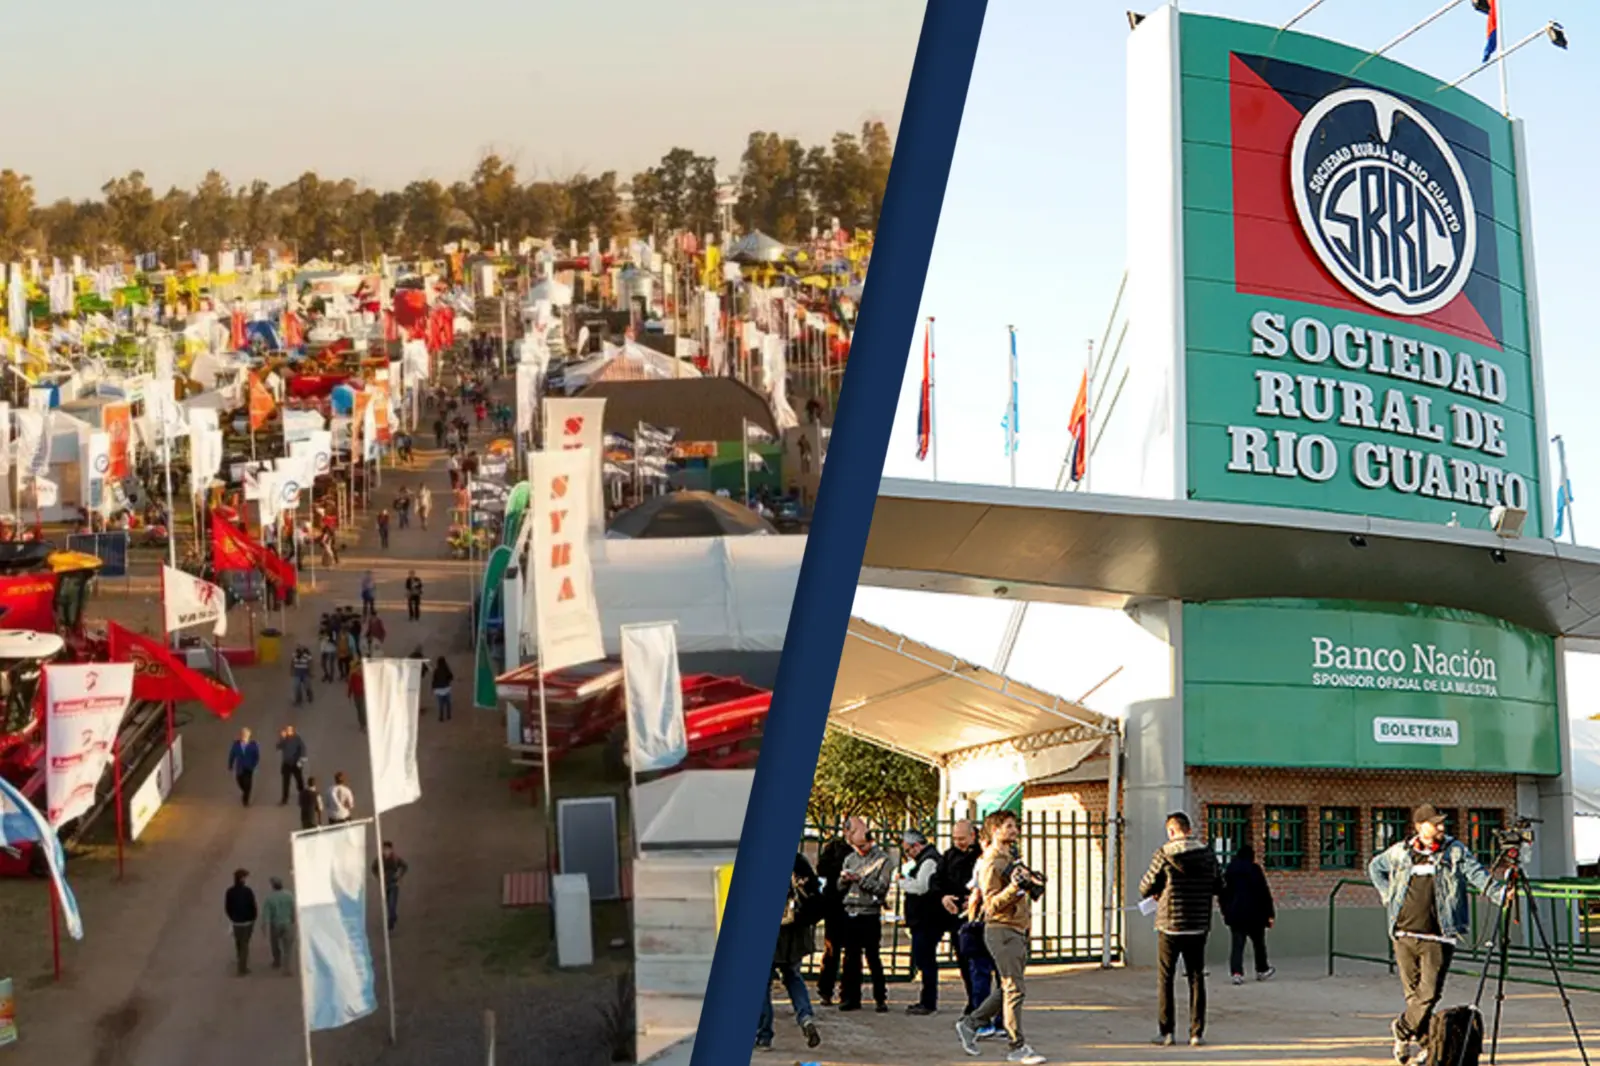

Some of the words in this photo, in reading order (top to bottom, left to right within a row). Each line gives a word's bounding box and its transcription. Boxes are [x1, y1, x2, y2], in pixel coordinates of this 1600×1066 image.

[1309, 146, 1351, 194] SOCIEDAD
[1351, 142, 1390, 160] RURAL
[1391, 150, 1407, 166] DE
[1427, 180, 1461, 233] CUARTO
[1250, 310, 1508, 405] SOCIEDAD
[1255, 369, 1445, 443] RURAL
[1449, 402, 1508, 457] DE
[1227, 425, 1339, 482] RIO
[1352, 441, 1529, 511] CUARTO
[1311, 636, 1406, 673] Banco
[1412, 643, 1498, 681] Nación
[1312, 672, 1375, 688] SPONSOR
[1376, 675, 1421, 691] OFICIAL
[1423, 679, 1438, 691] DE
[1440, 681, 1454, 692] LA
[1455, 682, 1498, 697] MUESTRA
[1380, 722, 1453, 738] BOLETERIA
